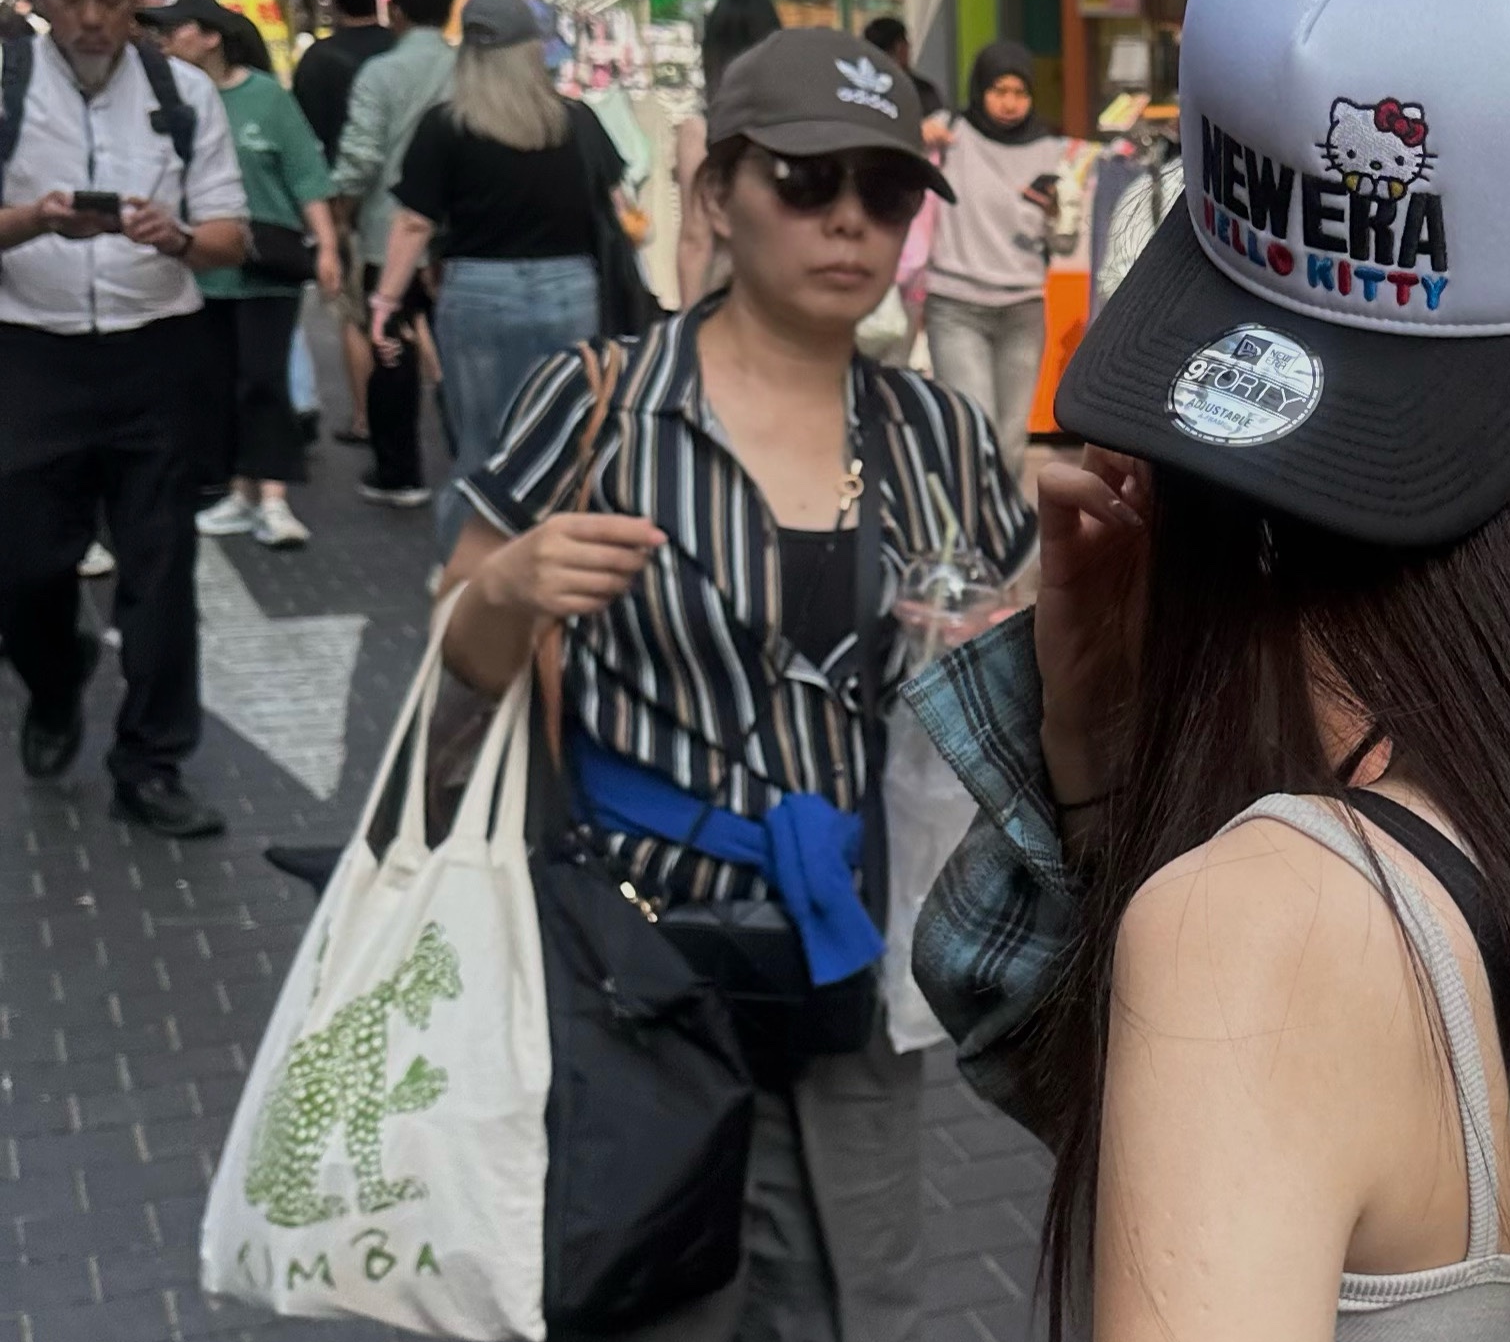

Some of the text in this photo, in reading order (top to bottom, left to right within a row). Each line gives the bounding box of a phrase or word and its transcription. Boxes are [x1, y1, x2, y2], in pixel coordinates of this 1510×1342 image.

[1201, 113, 1448, 273] NEW ERA
[1202, 195, 1449, 311] HELLO KITTY
[1265, 358, 1287, 371] ERA
[1270, 348, 1293, 364] NEW
[1183, 359, 1307, 413] 9FORTY
[1185, 396, 1254, 428] ADJUSTABLE
